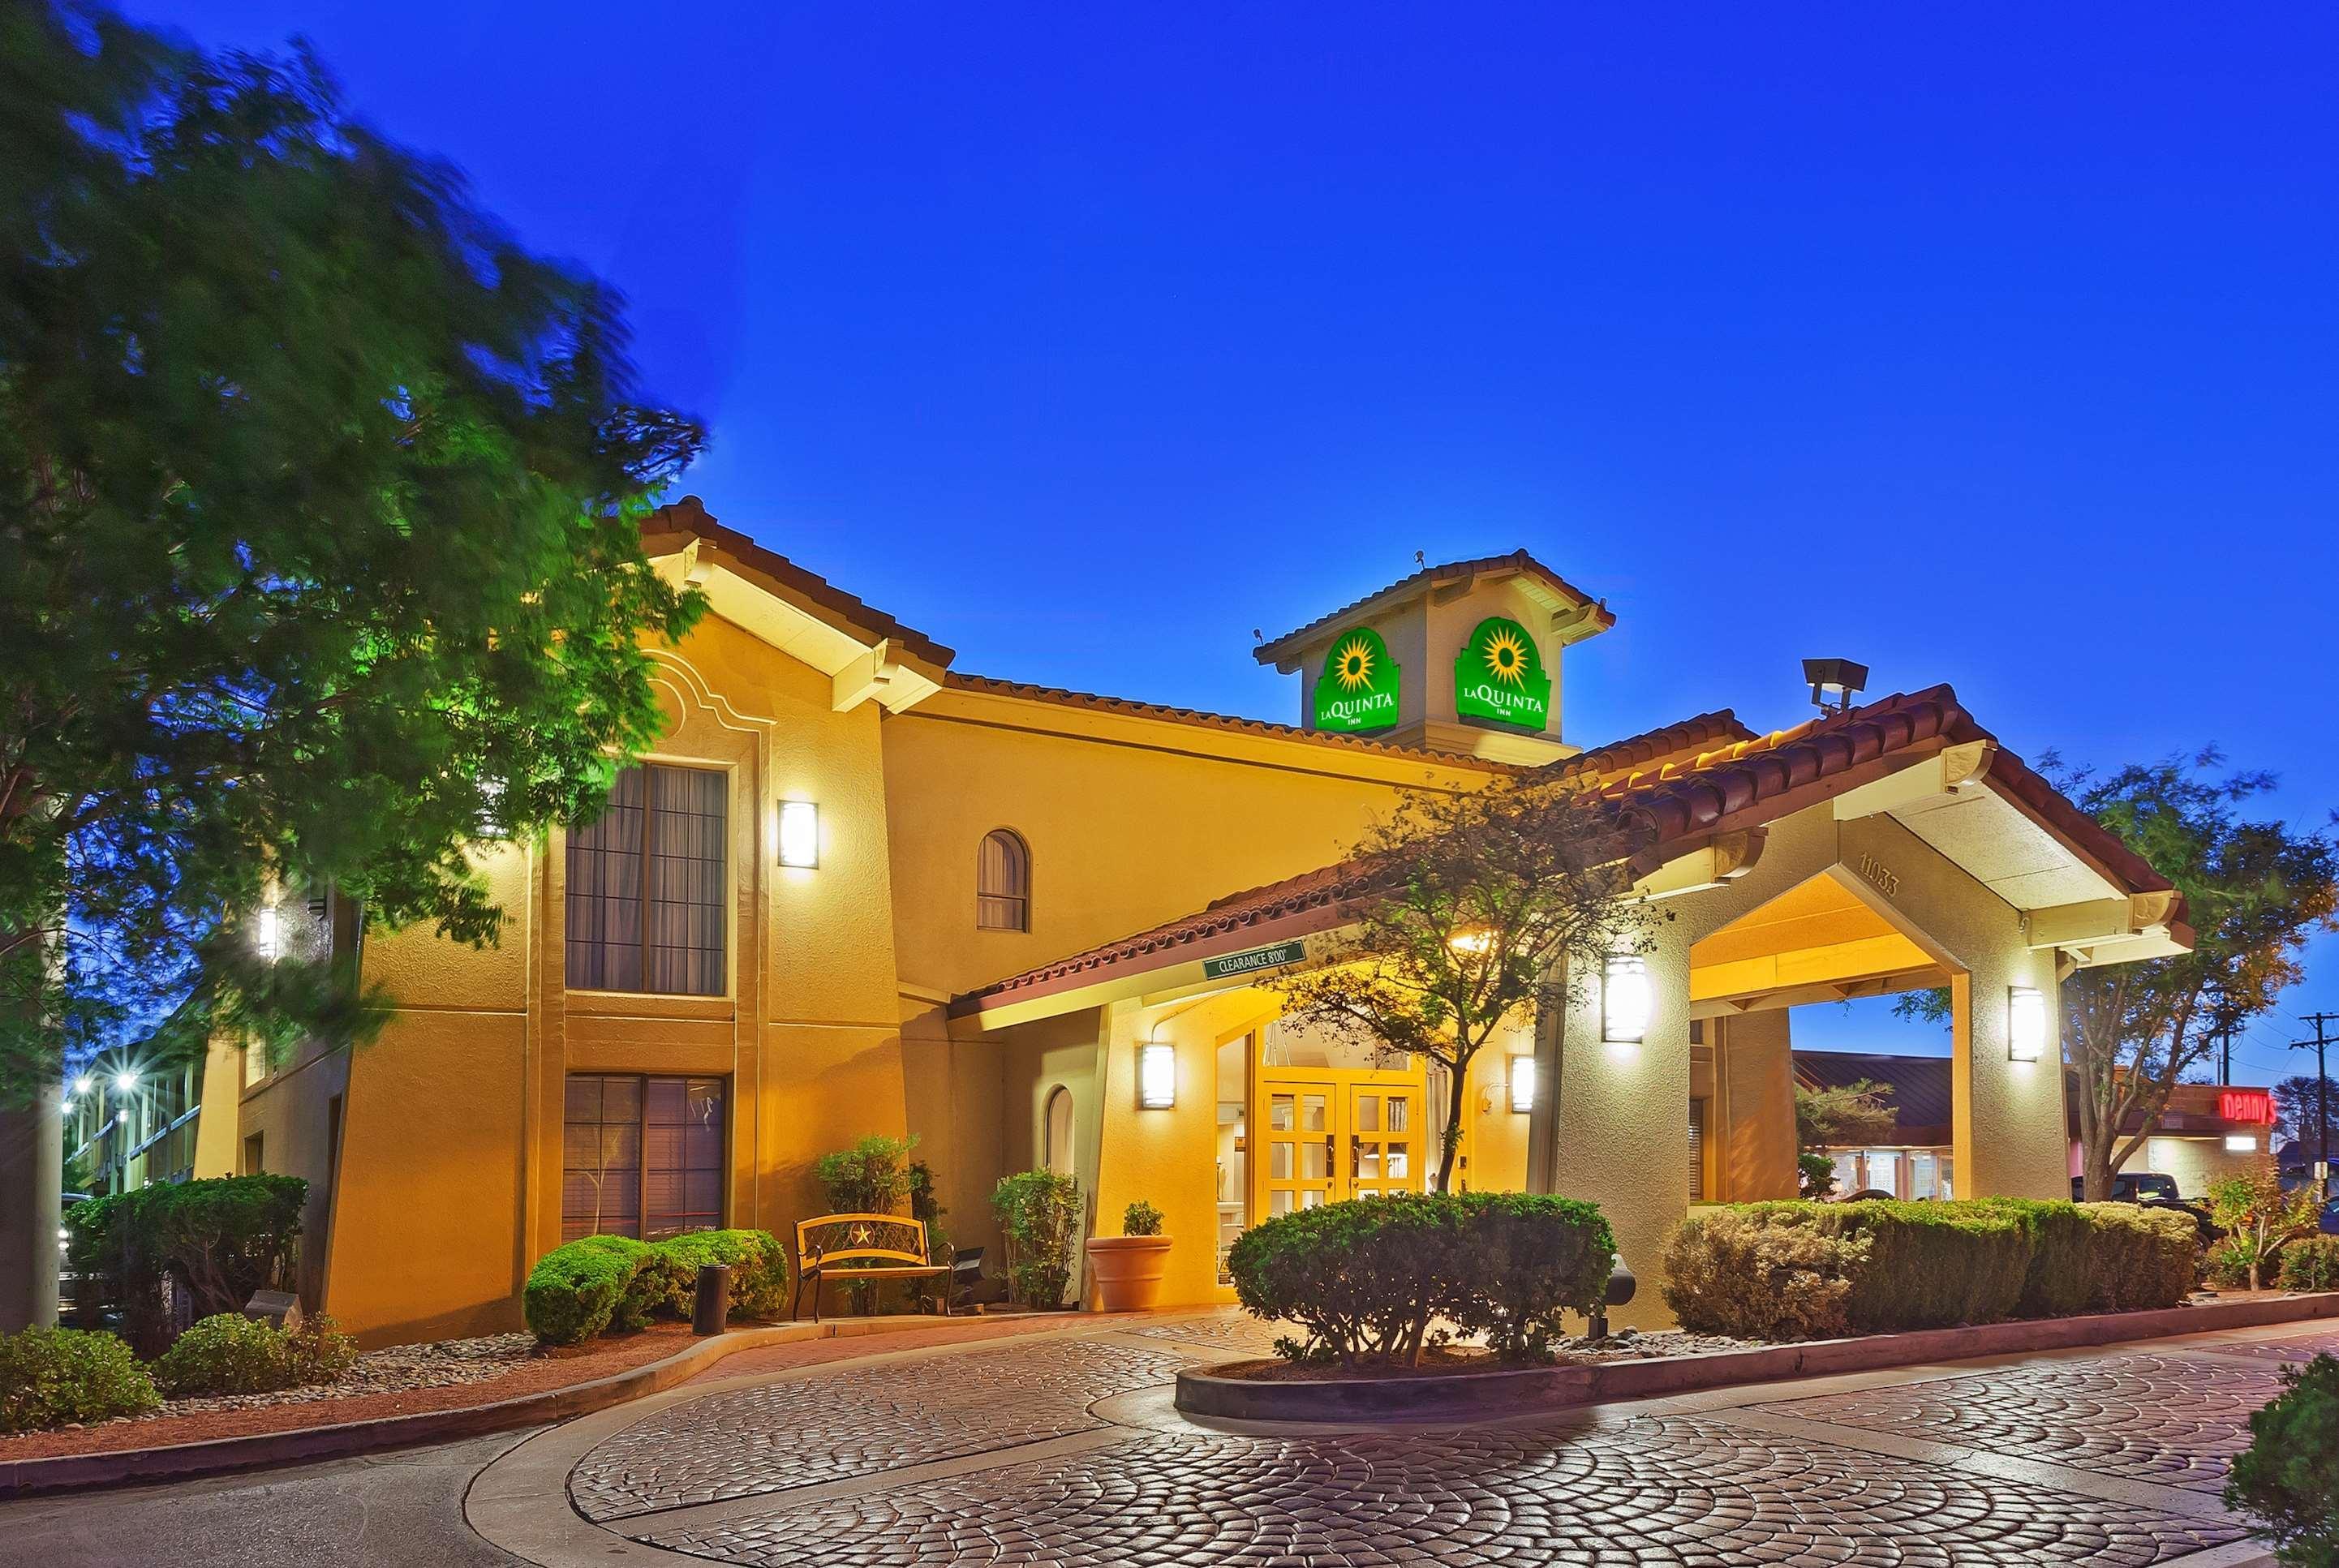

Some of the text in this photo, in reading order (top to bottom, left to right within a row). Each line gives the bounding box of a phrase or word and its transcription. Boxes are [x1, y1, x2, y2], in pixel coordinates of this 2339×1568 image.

[1331, 693, 1393, 719] QUINTA
[1477, 685, 1542, 713] QUINTA
[1348, 717, 1361, 725] INN
[1497, 708, 1511, 716] INN
[1860, 852, 1899, 897] 11033
[1219, 952, 1266, 973] CLEARANCE
